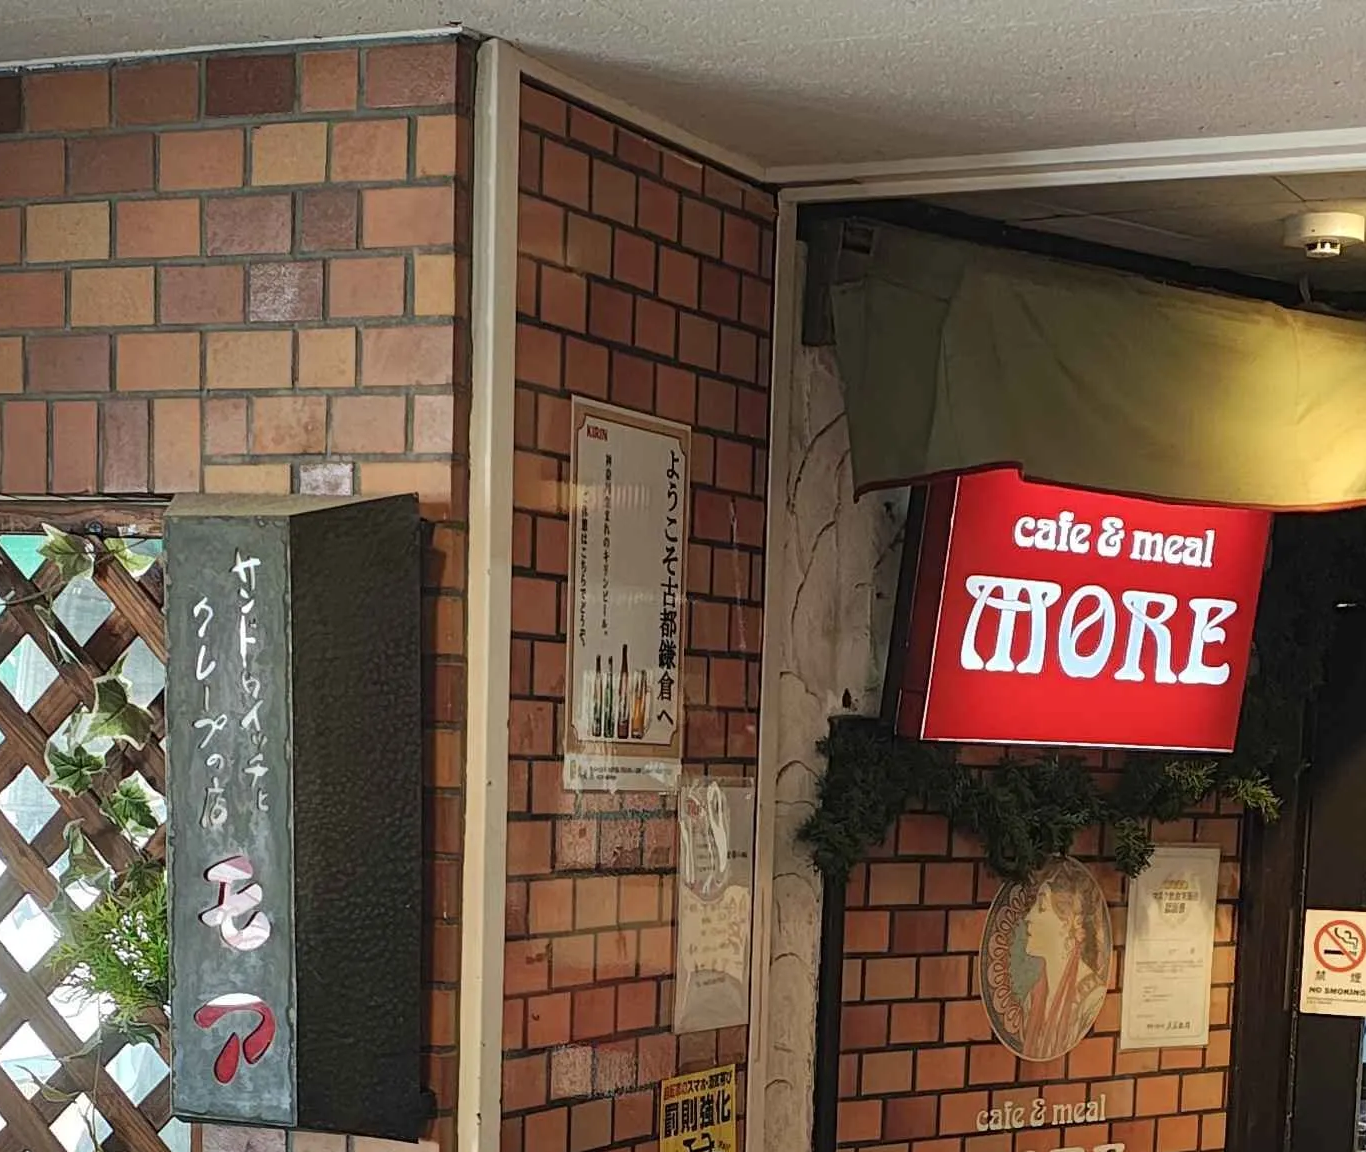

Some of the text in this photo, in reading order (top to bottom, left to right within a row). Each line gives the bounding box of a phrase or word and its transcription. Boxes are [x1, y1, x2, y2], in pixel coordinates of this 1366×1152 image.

[586, 424, 609, 442] KIRIN
[1014, 511, 1216, 569] cafe & meal
[656, 451, 680, 726] ようこそ古都鎌倉へ
[959, 573, 1239, 687] MORE
[193, 854, 277, 1084] モア
[1309, 986, 1366, 997] NO SMOKING
[664, 1089, 732, 1139] 罰則強化
[976, 1094, 1108, 1132] cafe & meal
